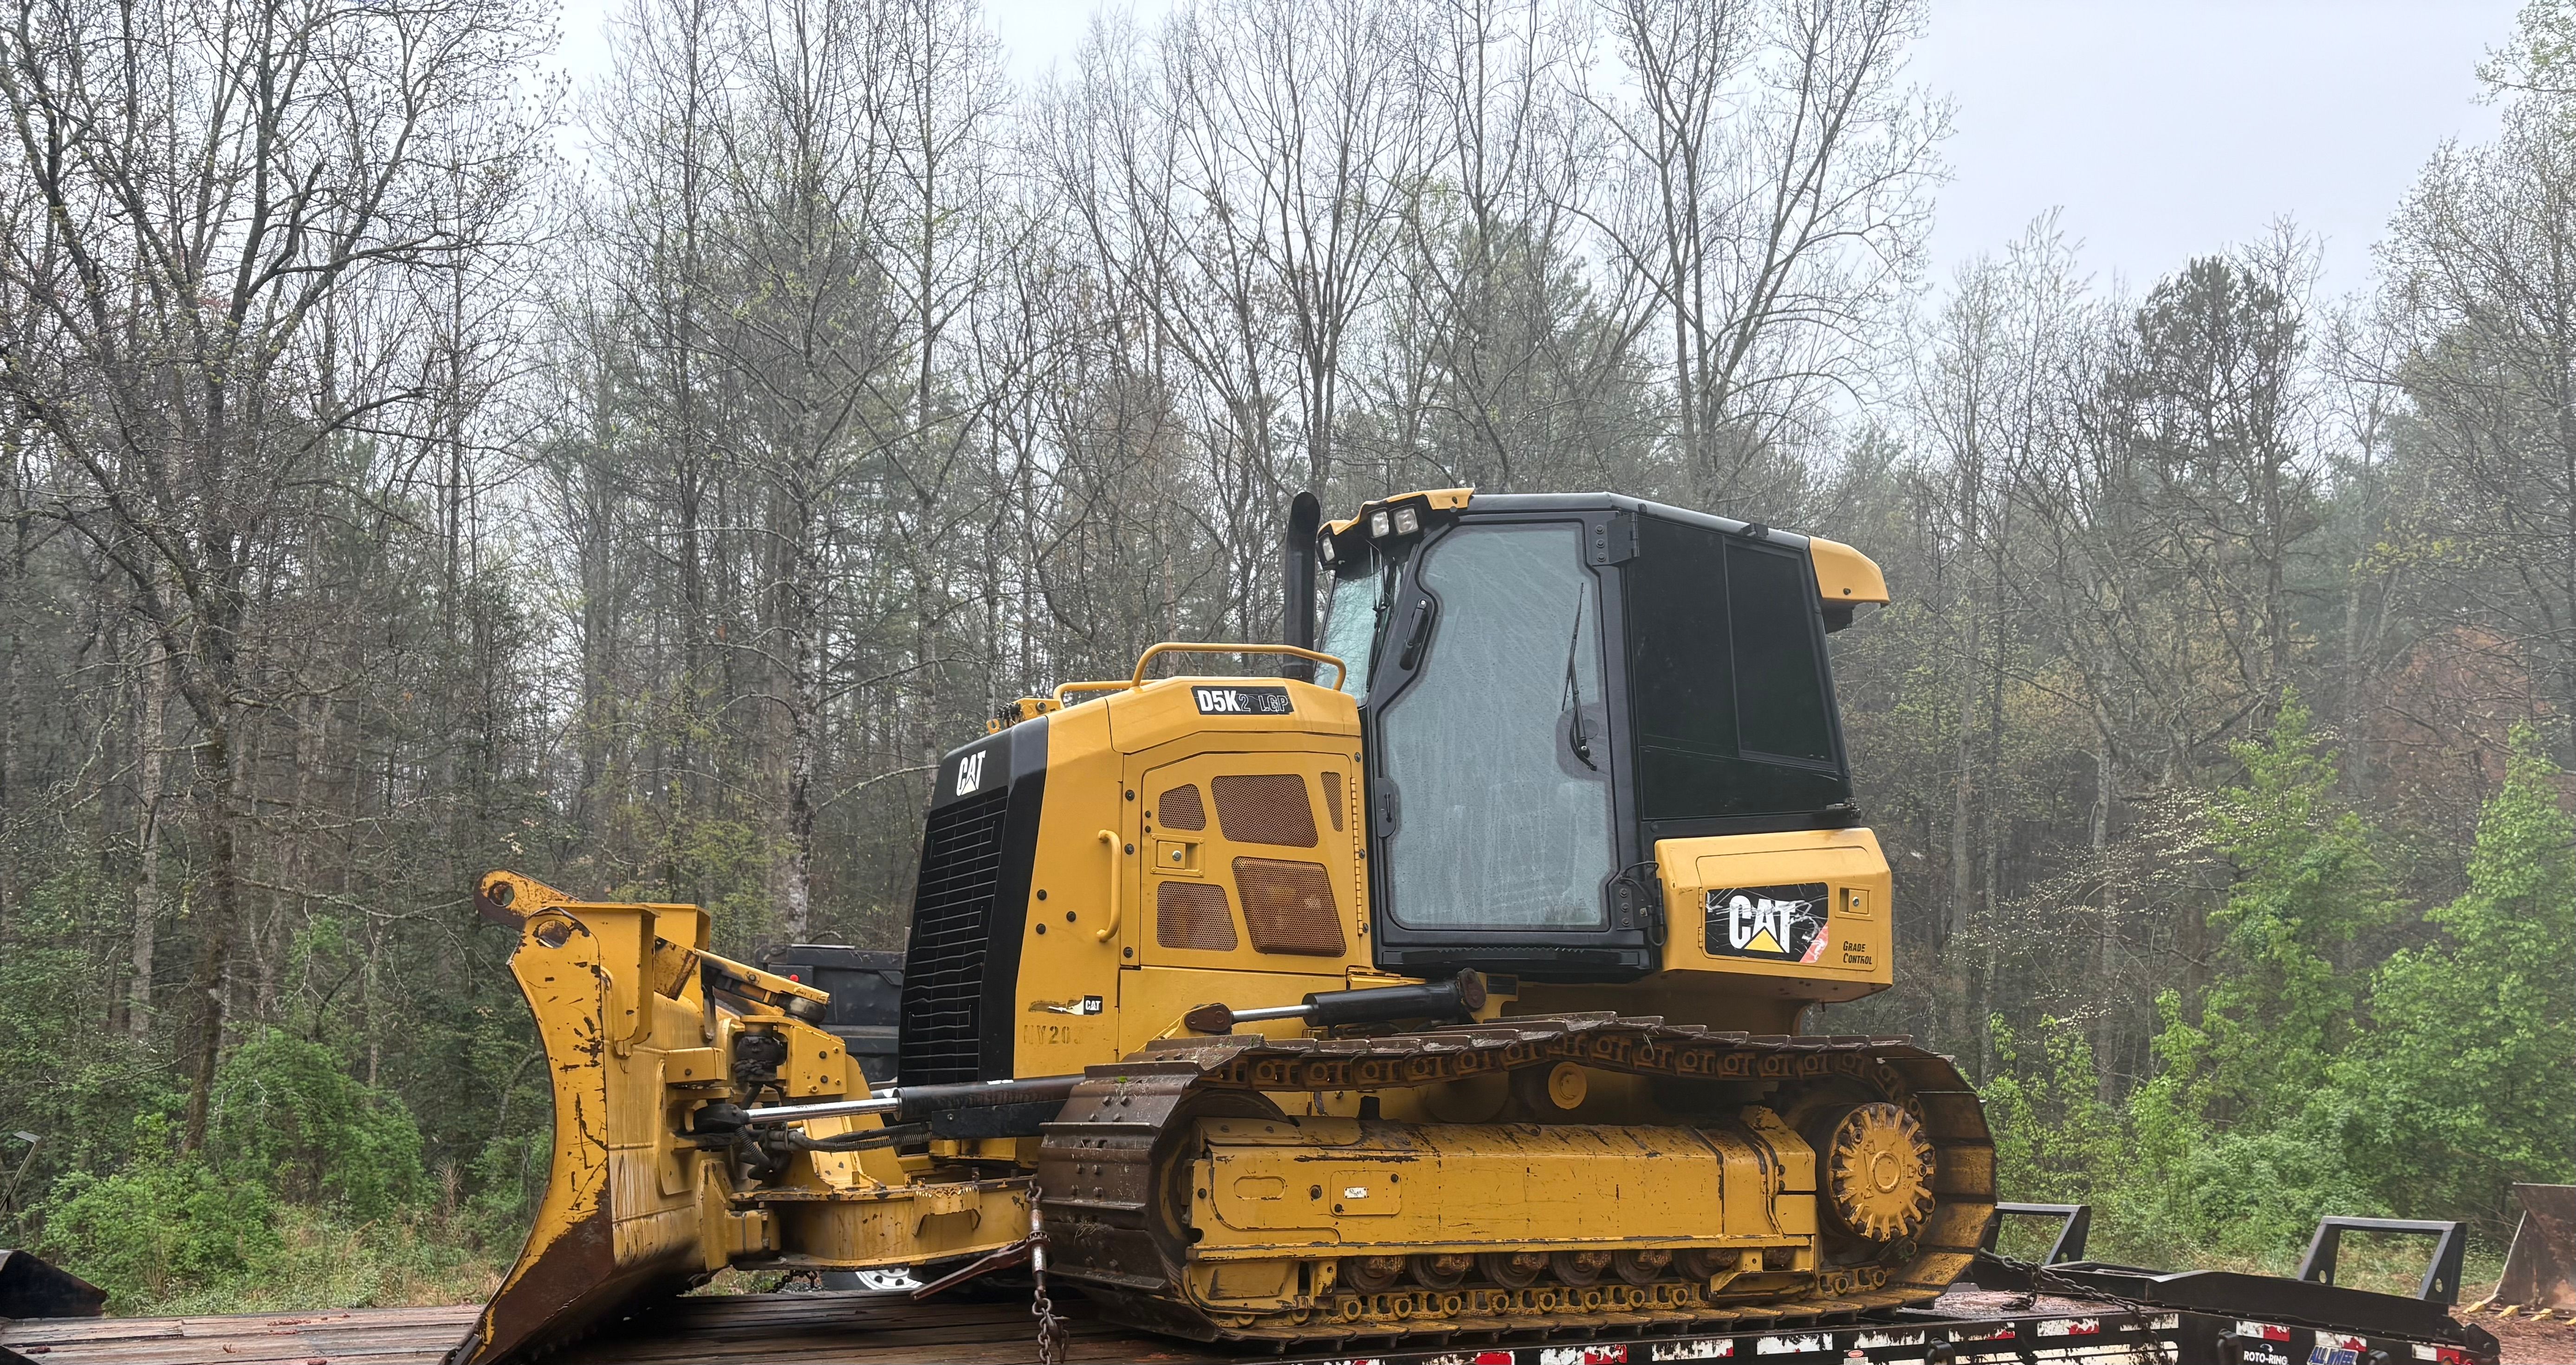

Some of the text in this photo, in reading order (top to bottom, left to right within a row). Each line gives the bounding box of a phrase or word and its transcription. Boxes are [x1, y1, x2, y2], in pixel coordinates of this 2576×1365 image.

[1258, 695, 1288, 712] LGP
[956, 750, 986, 796] CAT
[1729, 895, 1796, 954] CAT
[1085, 1000, 1101, 1011] CAT
[2243, 1350, 2289, 1365] ROTO-RING
